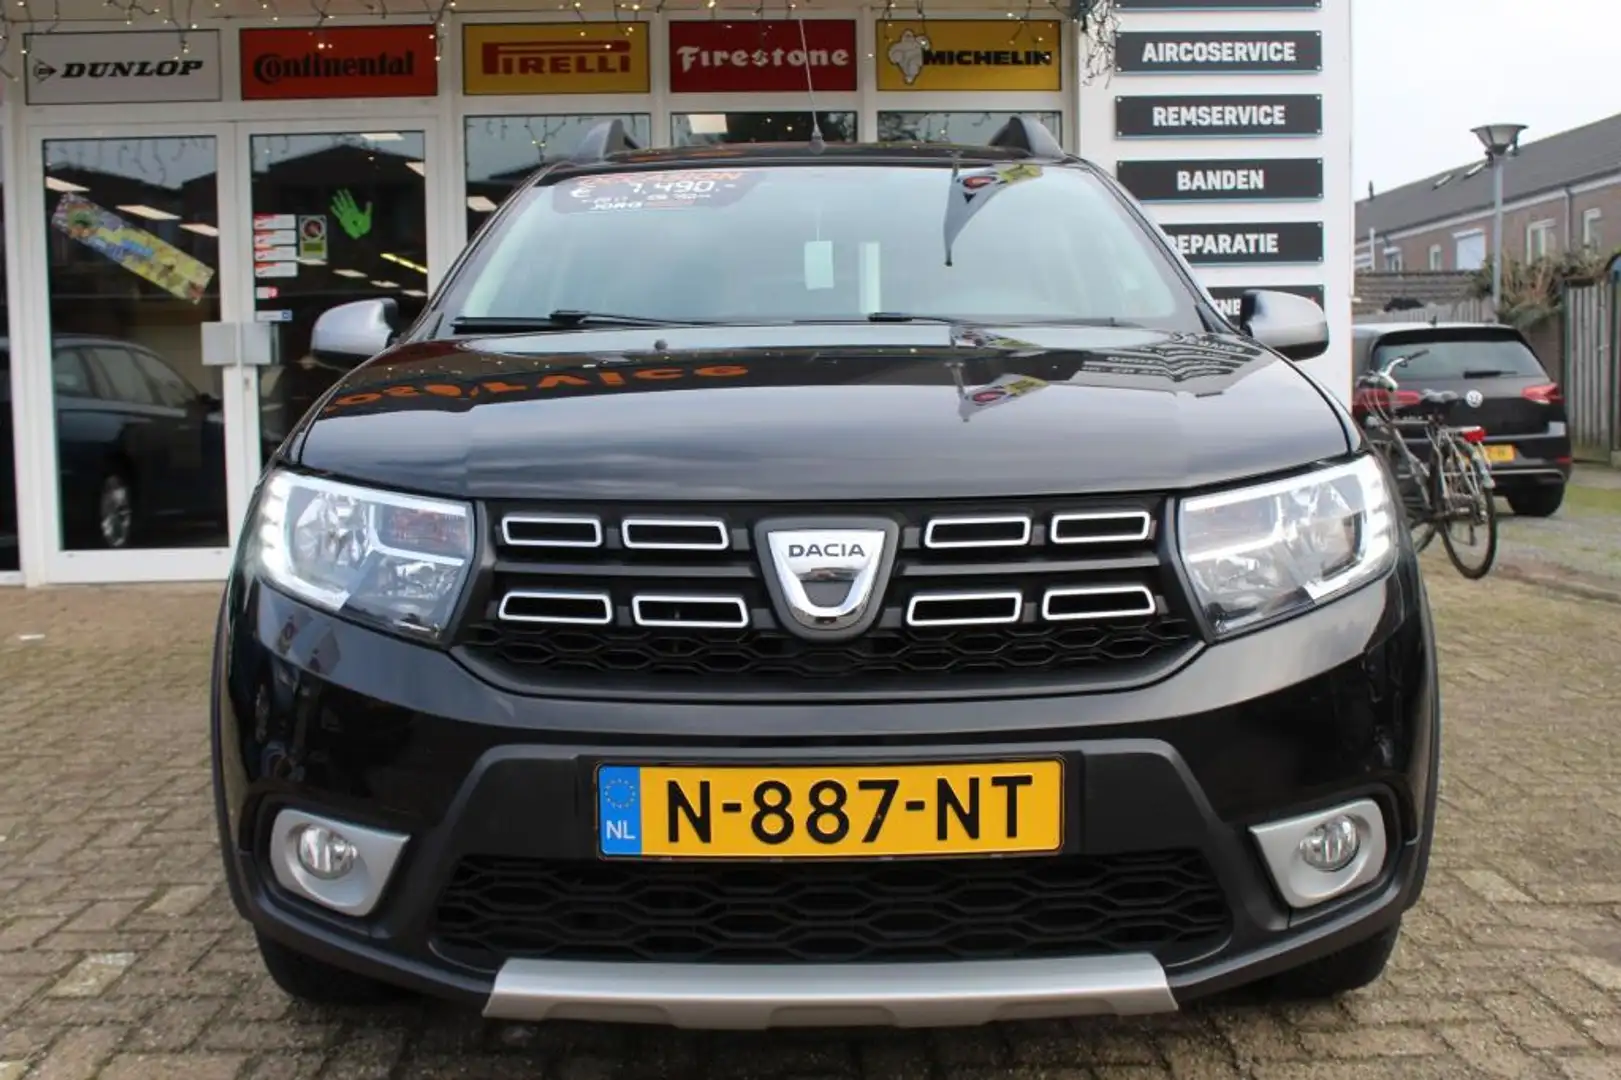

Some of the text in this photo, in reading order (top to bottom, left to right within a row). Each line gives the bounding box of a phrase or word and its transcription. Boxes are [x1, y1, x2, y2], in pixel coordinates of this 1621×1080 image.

[482, 40, 631, 74] PIRELLI
[677, 46, 849, 73] Firestone
[923, 50, 1052, 66] MICHELIN
[1142, 42, 1296, 62] AIRCOSERVICE
[61, 60, 203, 79] DUNLOP
[254, 51, 414, 85] Continental
[1152, 105, 1286, 126] REMSERVICE
[1177, 170, 1264, 191] BANDEN
[788, 544, 865, 557] DACIA
[666, 774, 1033, 845] N-887-NT
[605, 820, 635, 839] NL
